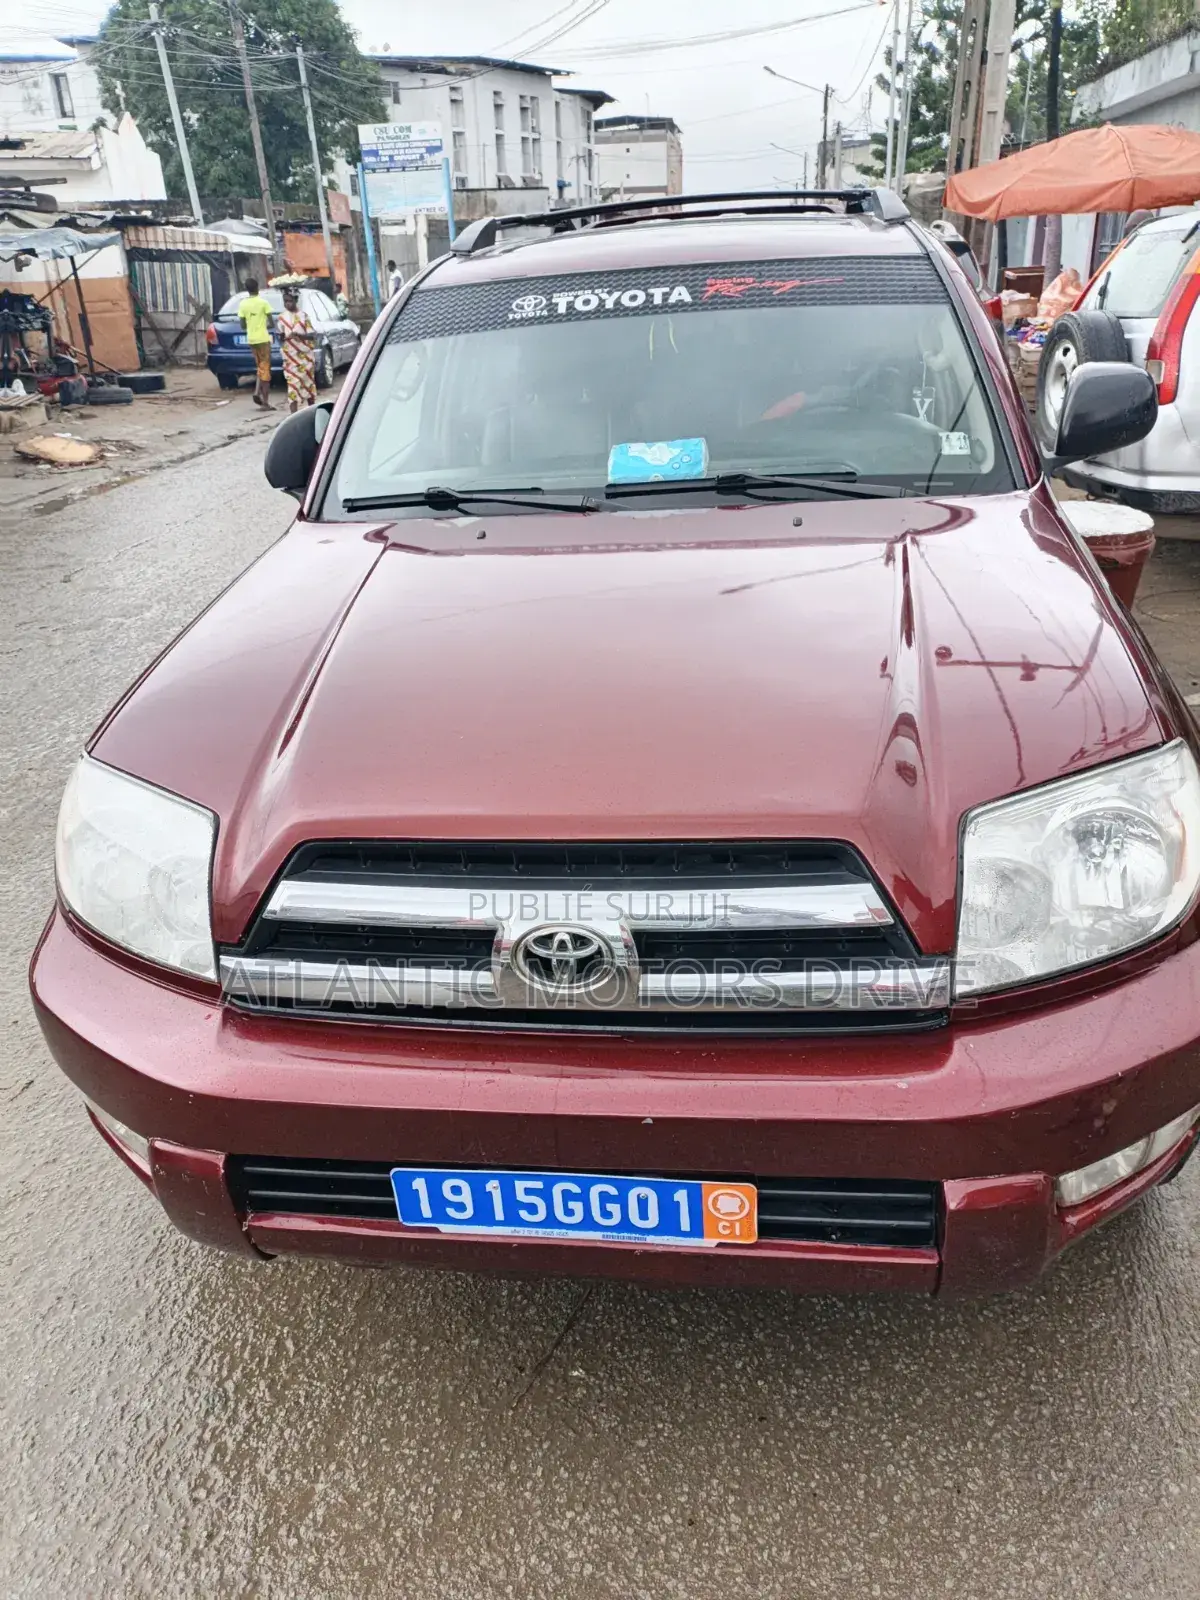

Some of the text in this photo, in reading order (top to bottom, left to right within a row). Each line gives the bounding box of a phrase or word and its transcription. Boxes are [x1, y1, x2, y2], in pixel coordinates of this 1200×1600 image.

[393, 125, 412, 134] COM
[552, 286, 692, 314] TOYOTA
[508, 310, 548, 320] TOYOTA
[411, 1177, 691, 1233] 1915GG01
[718, 1220, 740, 1236] CI
